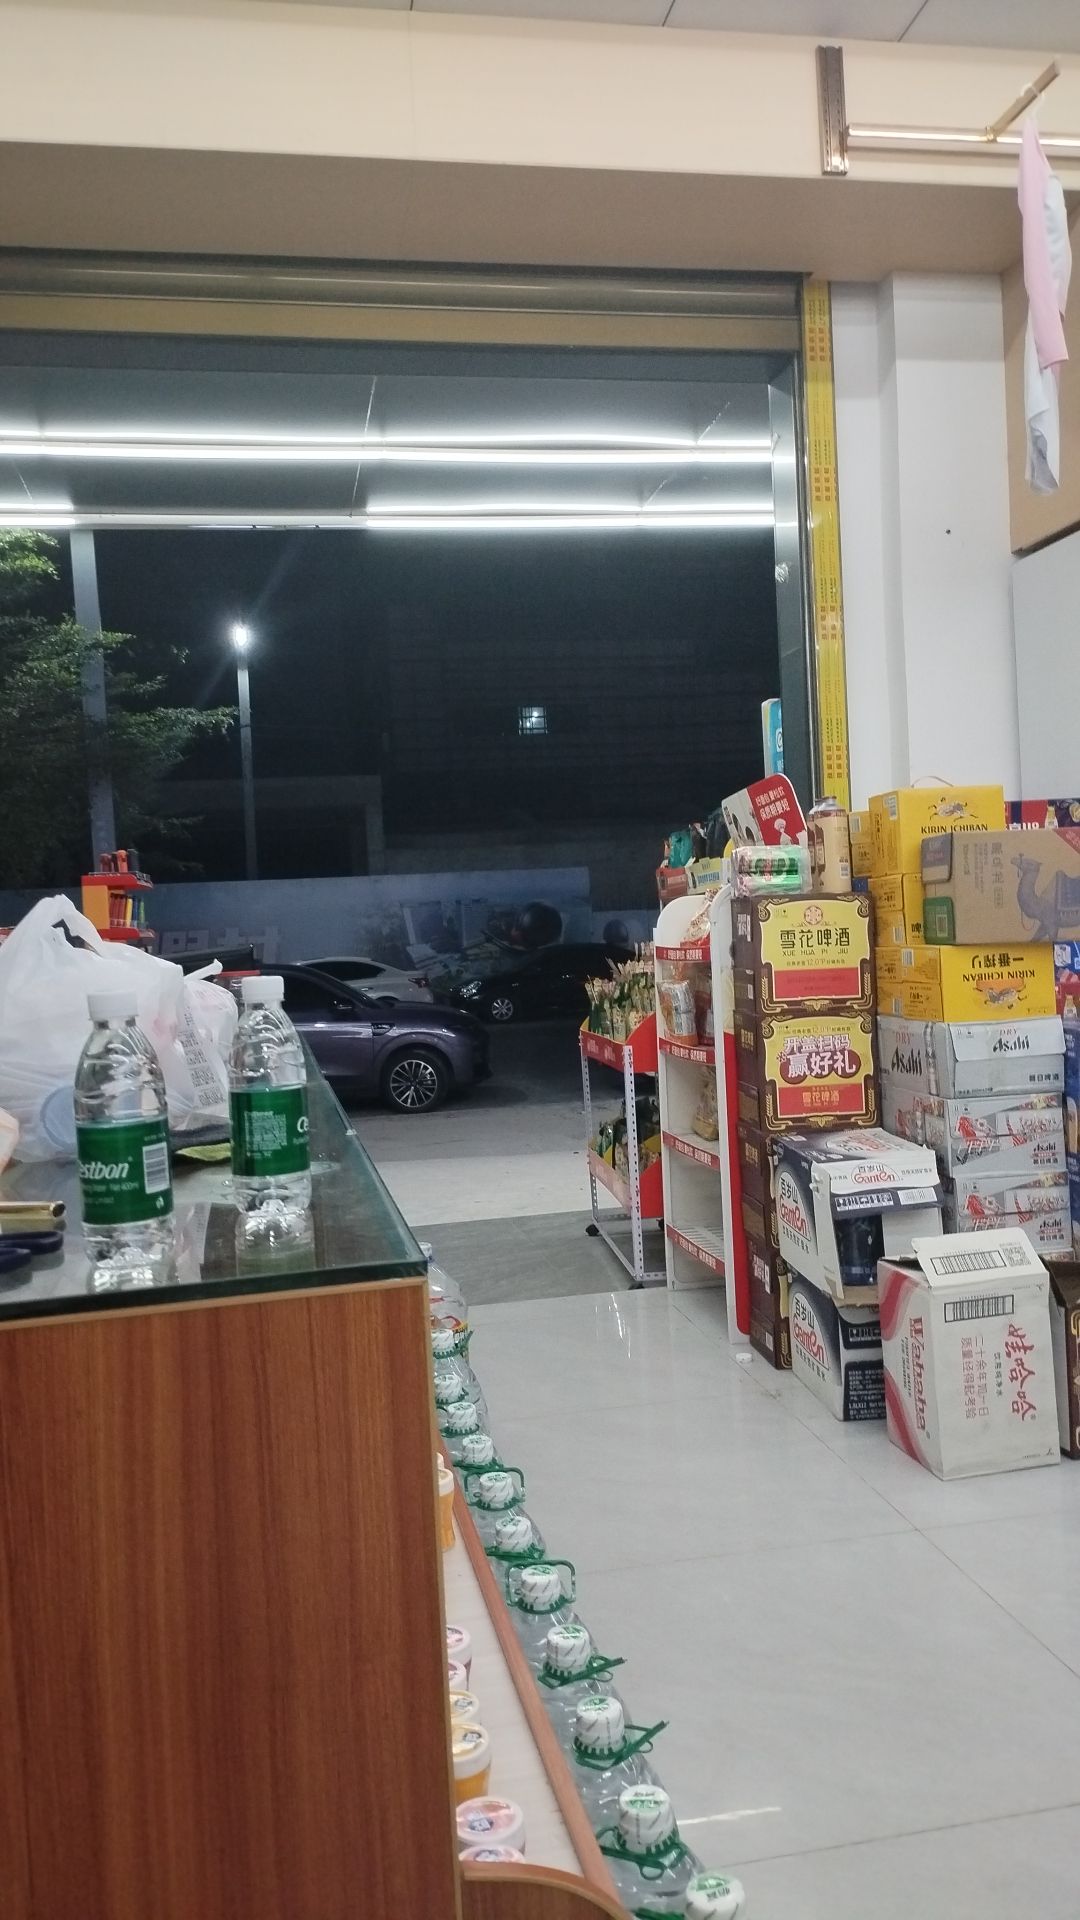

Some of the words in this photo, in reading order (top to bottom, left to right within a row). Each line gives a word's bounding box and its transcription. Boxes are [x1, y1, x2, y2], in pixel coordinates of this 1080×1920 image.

[920, 825, 947, 834] KIRIN
[950, 823, 988, 833] ICHIBAN
[780, 927, 850, 949] 雪花啤酒
[962, 971, 1006, 982] ICHIBAN
[1008, 969, 1035, 979] KIRIN
[784, 1034, 851, 1054] 开盖扫码
[992, 1035, 1030, 1053] Asahi
[787, 1050, 857, 1078] 赢好礼
[891, 1047, 923, 1077] Asahi
[1033, 1141, 1056, 1152] Asahi
[857, 1164, 885, 1173] 百岁山
[779, 1178, 798, 1204] 百岁山
[1039, 1218, 1062, 1229] Asahi
[794, 1298, 815, 1330] 百岁山
[909, 1316, 928, 1431] Wahaha
[1004, 1322, 1037, 1421] 娃哈哈
